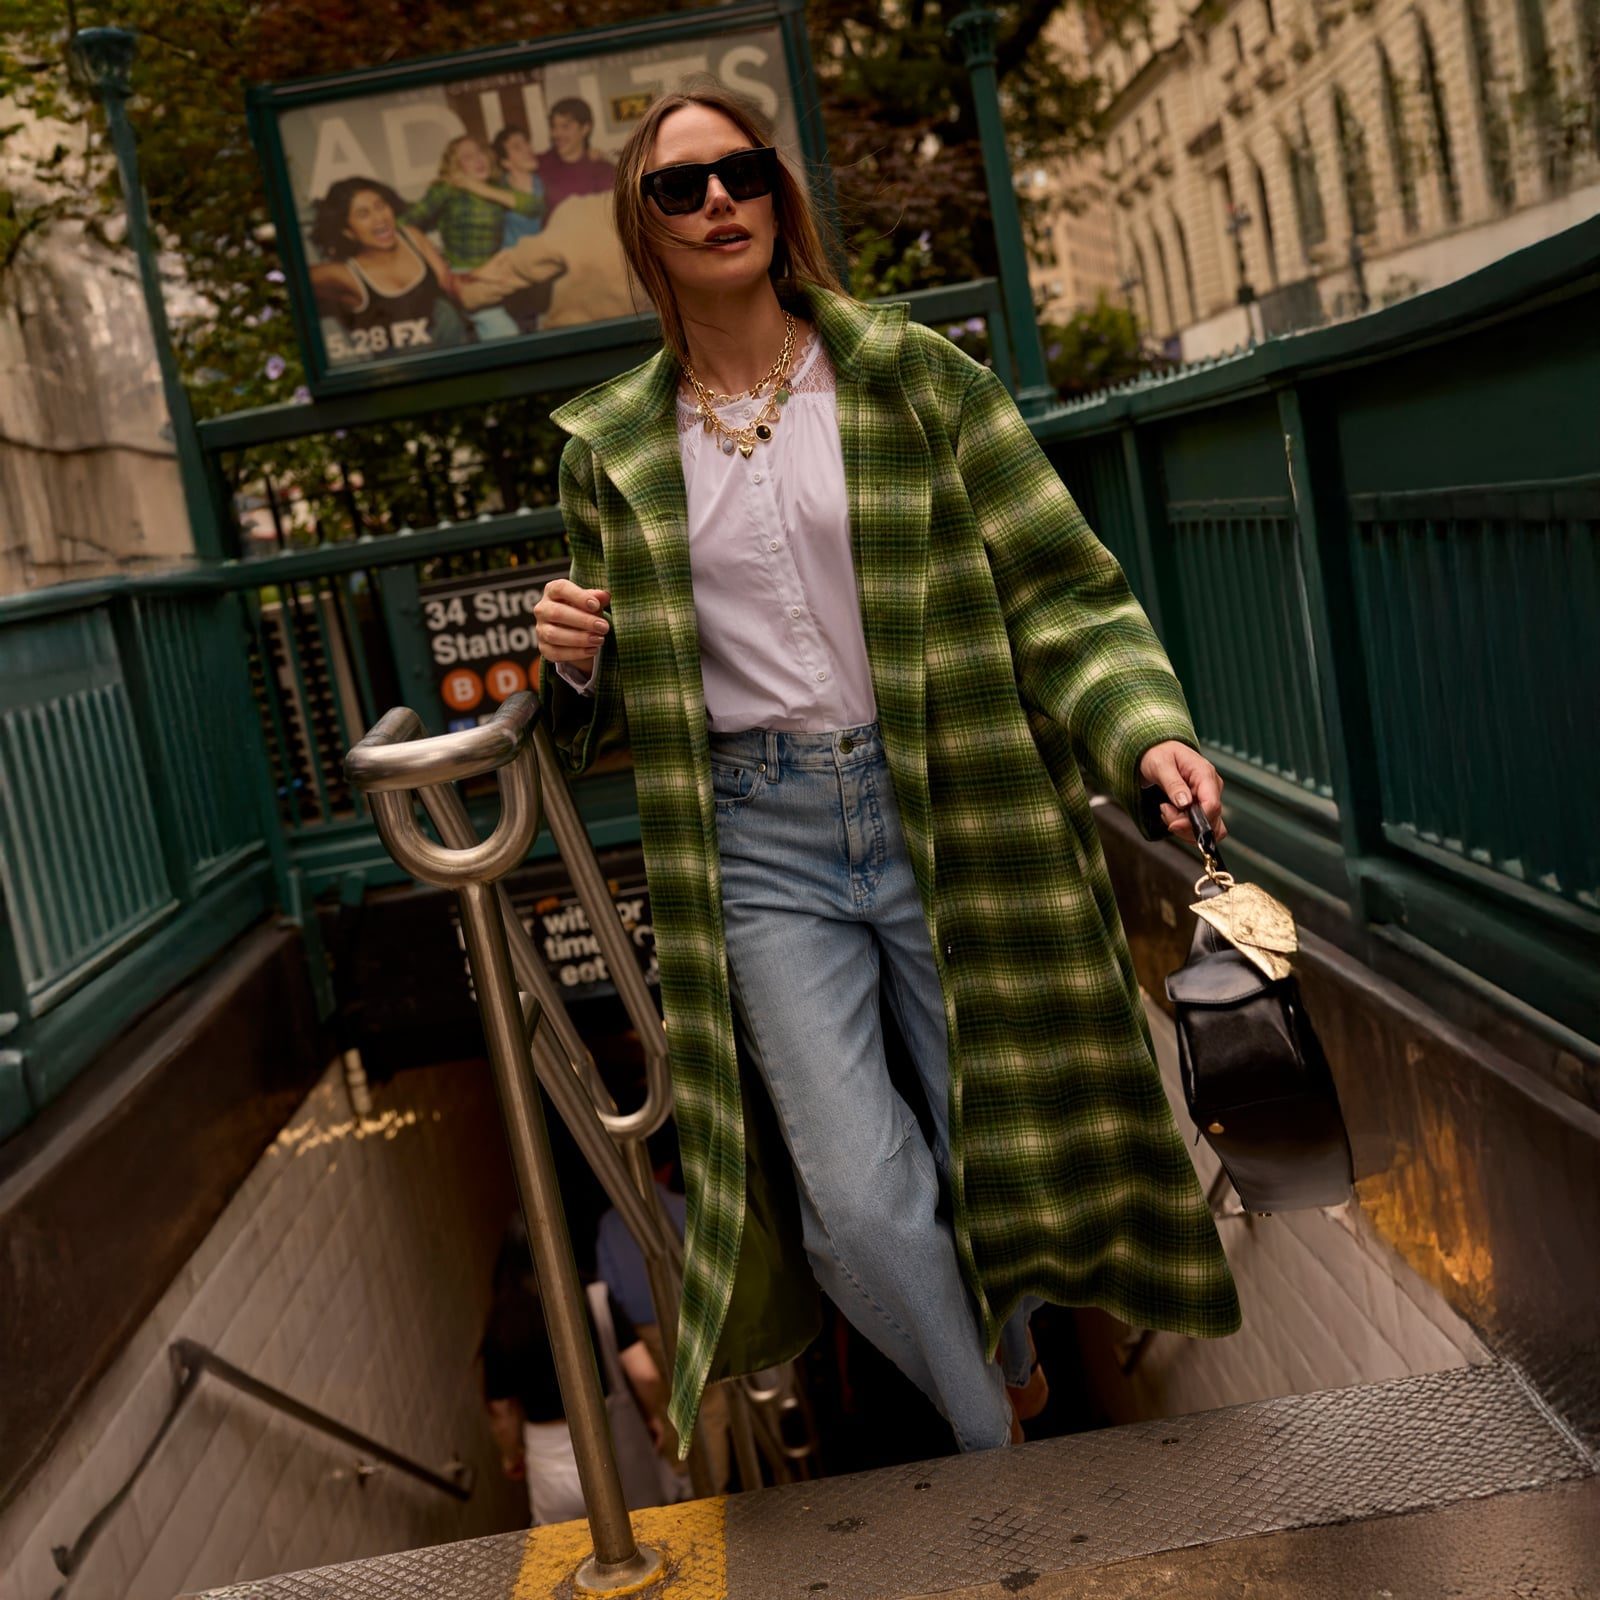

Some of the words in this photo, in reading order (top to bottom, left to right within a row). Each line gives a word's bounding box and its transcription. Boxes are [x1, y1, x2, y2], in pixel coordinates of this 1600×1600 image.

[325, 326, 389, 360] 5.28
[391, 317, 432, 348] FX
[424, 597, 468, 631] 34
[473, 589, 541, 622] Stre
[452, 677, 475, 702] B
[495, 669, 519, 694] D
